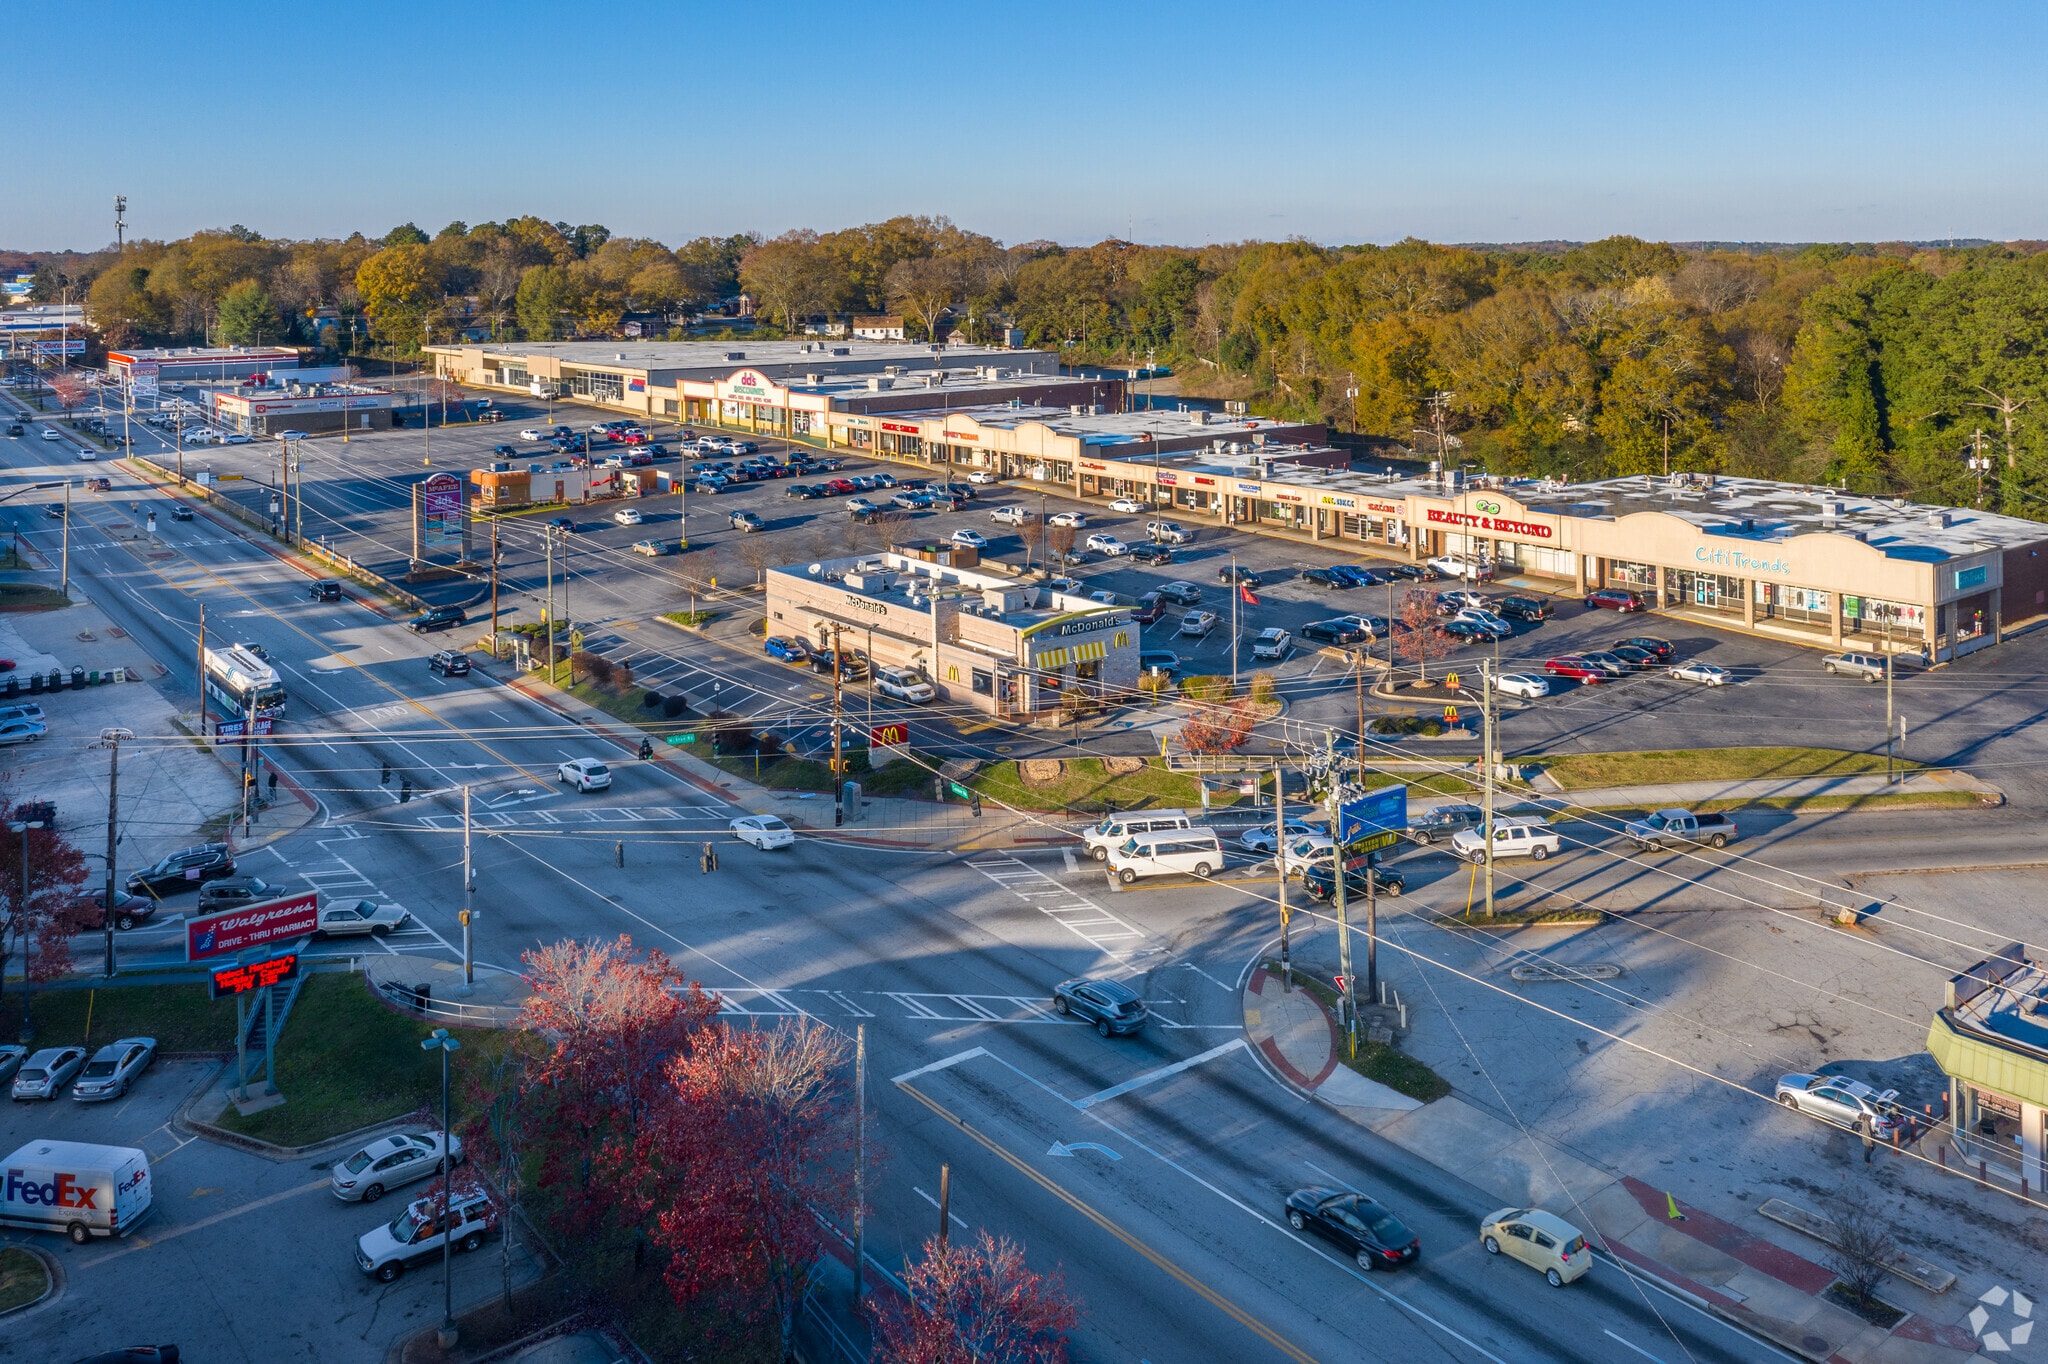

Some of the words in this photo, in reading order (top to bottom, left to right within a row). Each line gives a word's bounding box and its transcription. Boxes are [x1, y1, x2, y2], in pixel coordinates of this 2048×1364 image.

[741, 372, 757, 387] dd's
[733, 385, 765, 396] DISCOUNTS
[1427, 509, 1480, 527] BEAUTY
[1481, 517, 1493, 530] &
[1493, 518, 1552, 538] BEYOND
[845, 595, 887, 615] McDonald's
[1061, 616, 1121, 635] McDonald's
[220, 723, 243, 733] TIRES
[219, 902, 315, 931] Walgreens
[218, 936, 243, 949] DRIVE
[249, 930, 271, 942] THRU
[273, 918, 316, 936] PHARMACY
[215, 967, 245, 982] Select
[248, 955, 295, 973] Hershey's
[260, 965, 291, 978] Candy
[7, 1168, 98, 1210] FedEx
[118, 1168, 147, 1197] FedEx
[58, 1208, 85, 1217] Express
